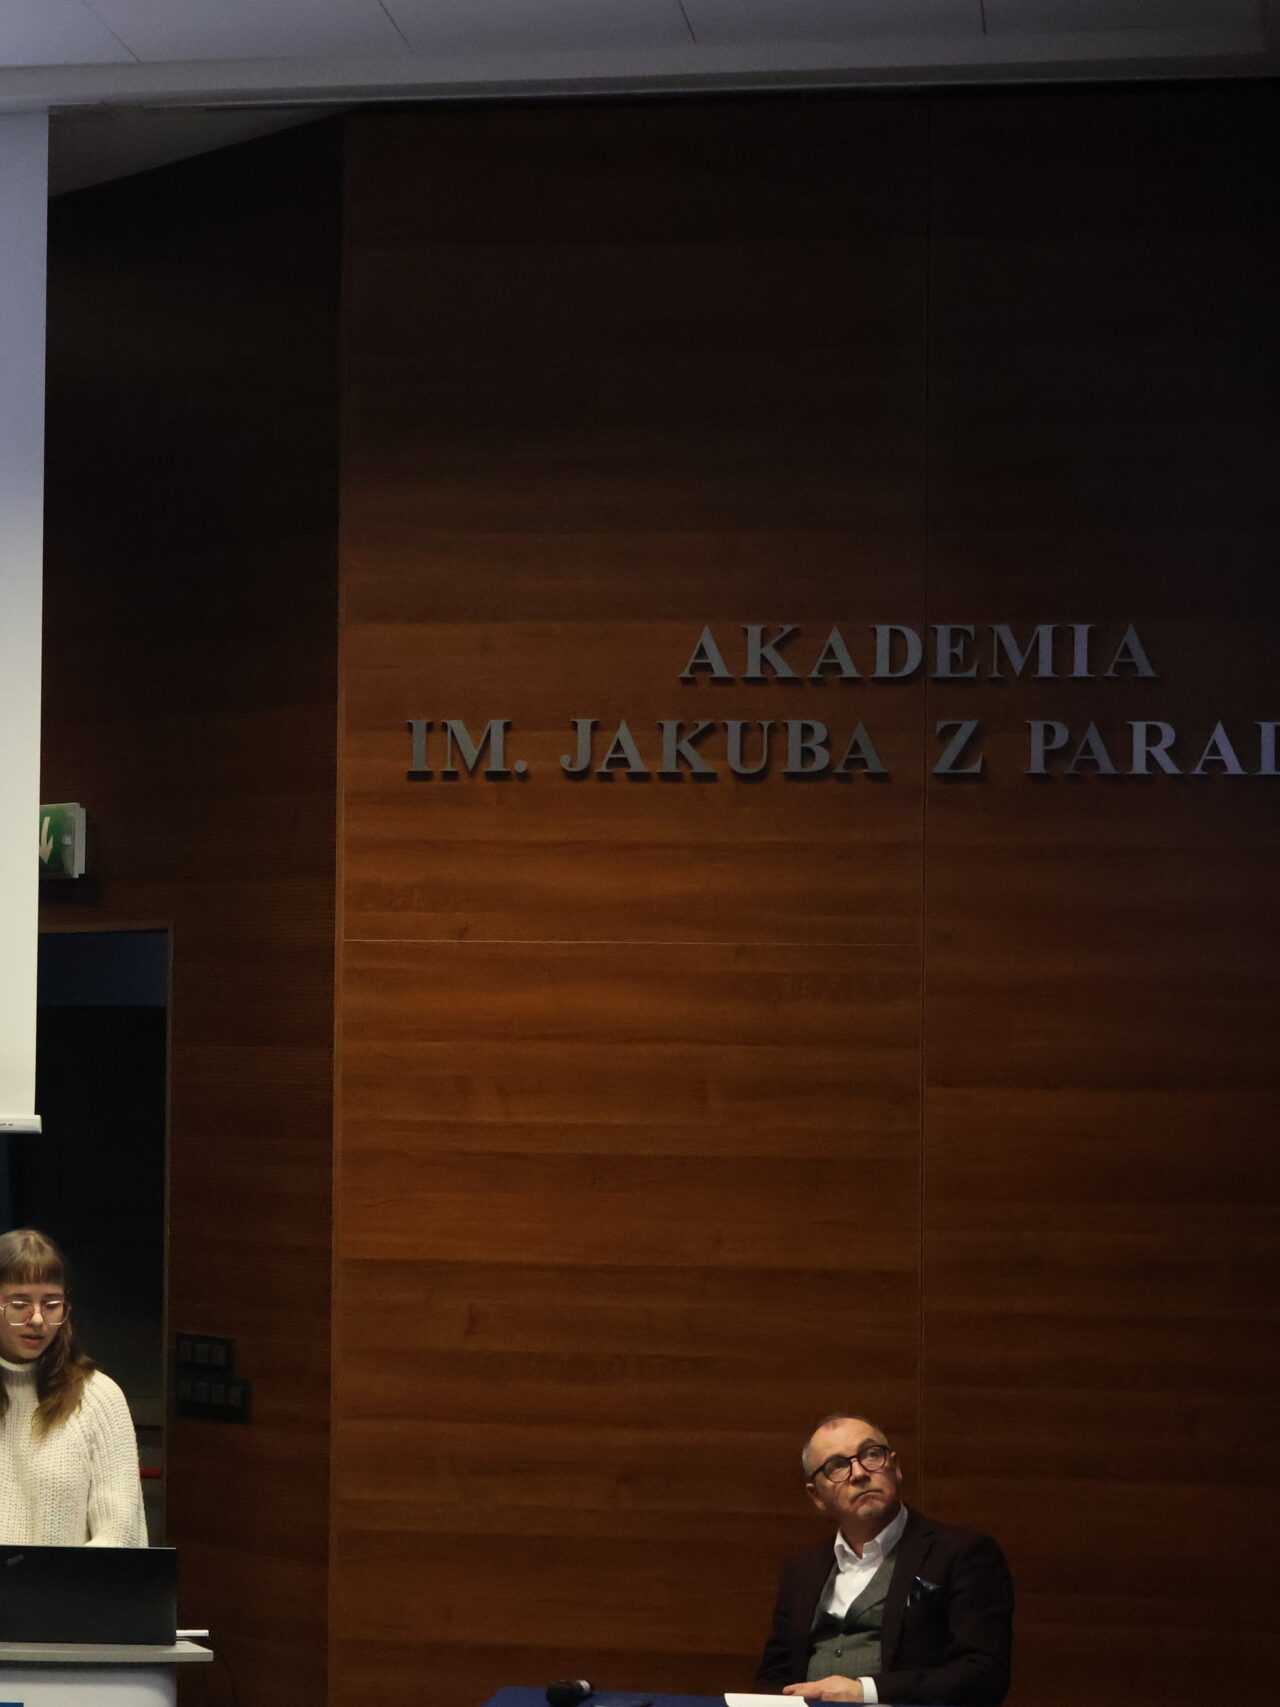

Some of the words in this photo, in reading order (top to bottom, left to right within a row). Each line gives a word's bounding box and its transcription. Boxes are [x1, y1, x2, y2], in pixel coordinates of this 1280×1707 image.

[678, 622, 1159, 680] AKADEMIA
[406, 717, 528, 776] IM.
[560, 717, 889, 776] JAKUBA
[933, 717, 985, 776] Z
